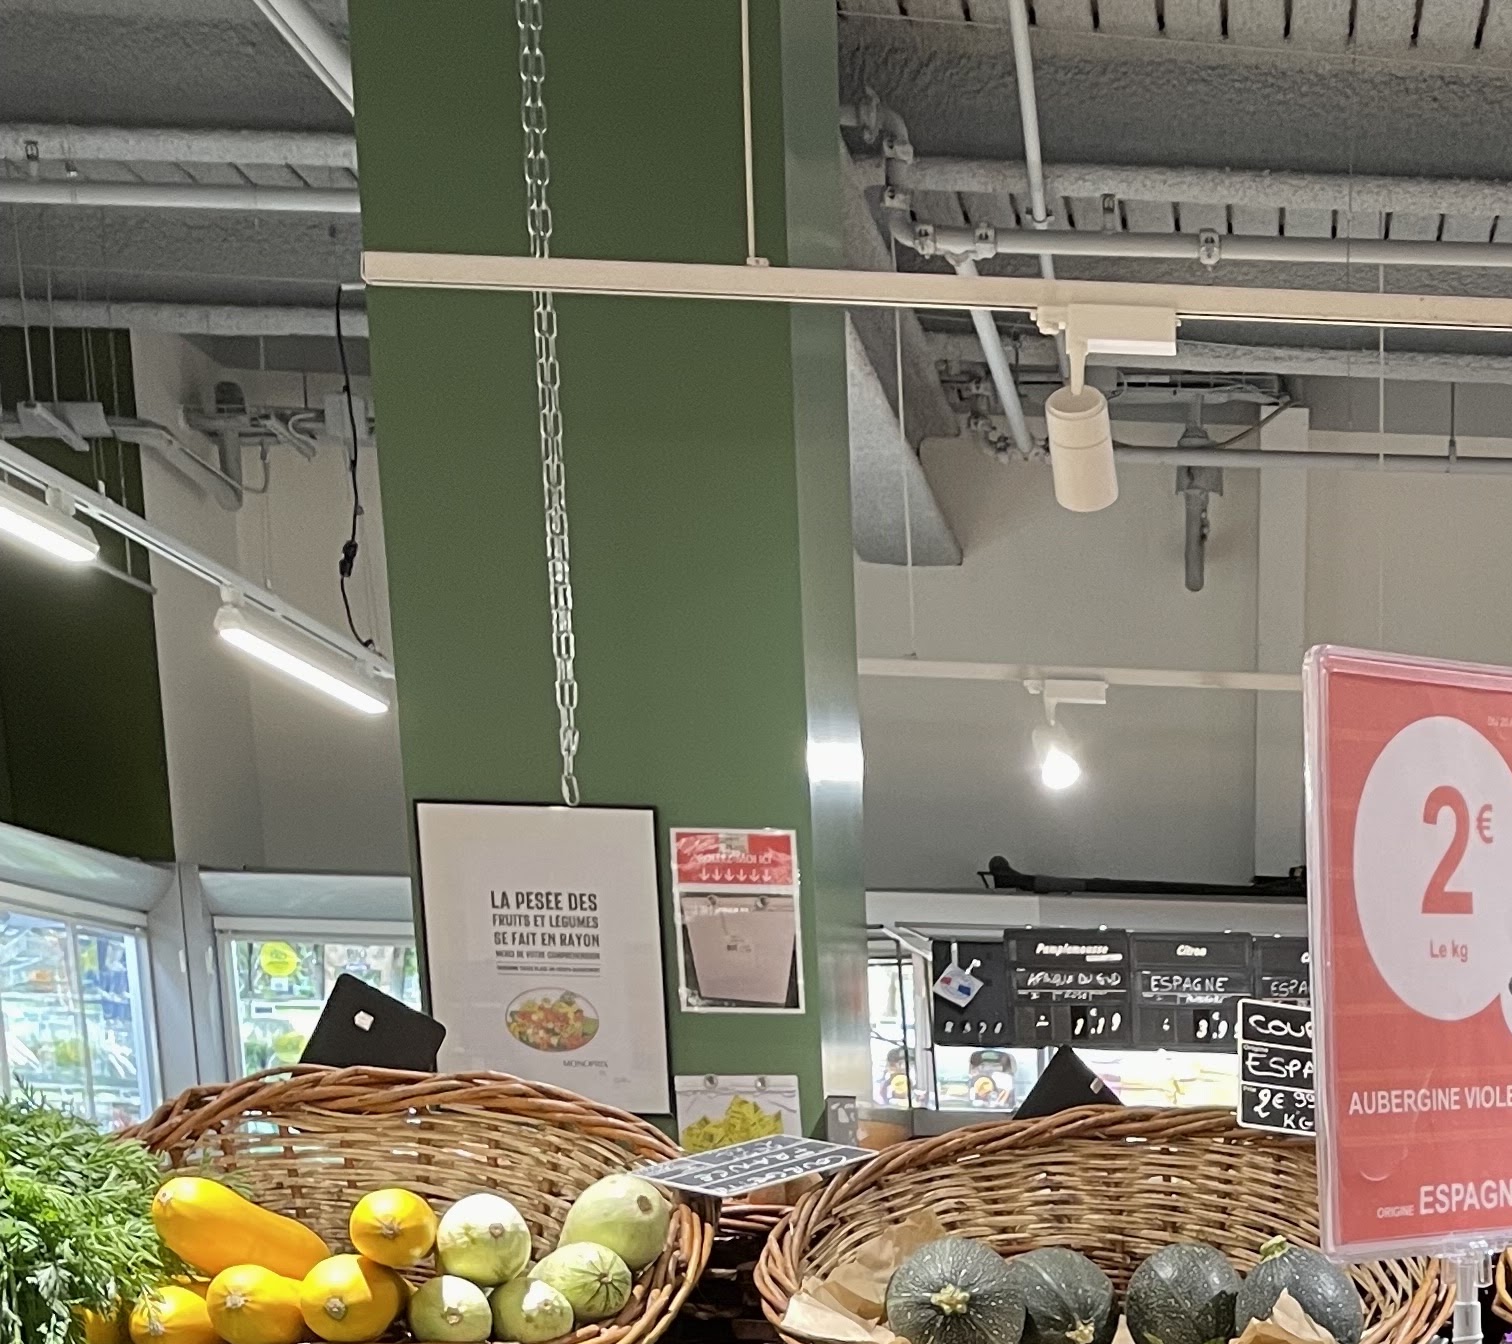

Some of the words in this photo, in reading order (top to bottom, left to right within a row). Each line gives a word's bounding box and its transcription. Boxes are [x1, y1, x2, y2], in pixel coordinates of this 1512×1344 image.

[490, 889, 511, 910] LA
[568, 892, 598, 912] DES
[492, 913, 531, 927] FRUITS
[533, 914, 546, 928] ET
[494, 931, 508, 946] SE
[511, 932, 537, 946] FAIT
[541, 933, 556, 947] EN
[560, 933, 600, 948] RAYON
[1430, 939, 1447, 958] Le
[1452, 938, 1468, 962] kg
[1150, 976, 1229, 992] ESPAGNE
[1348, 1086, 1461, 1116] AUBERGINE
[1376, 1204, 1415, 1219] ORIGINE
